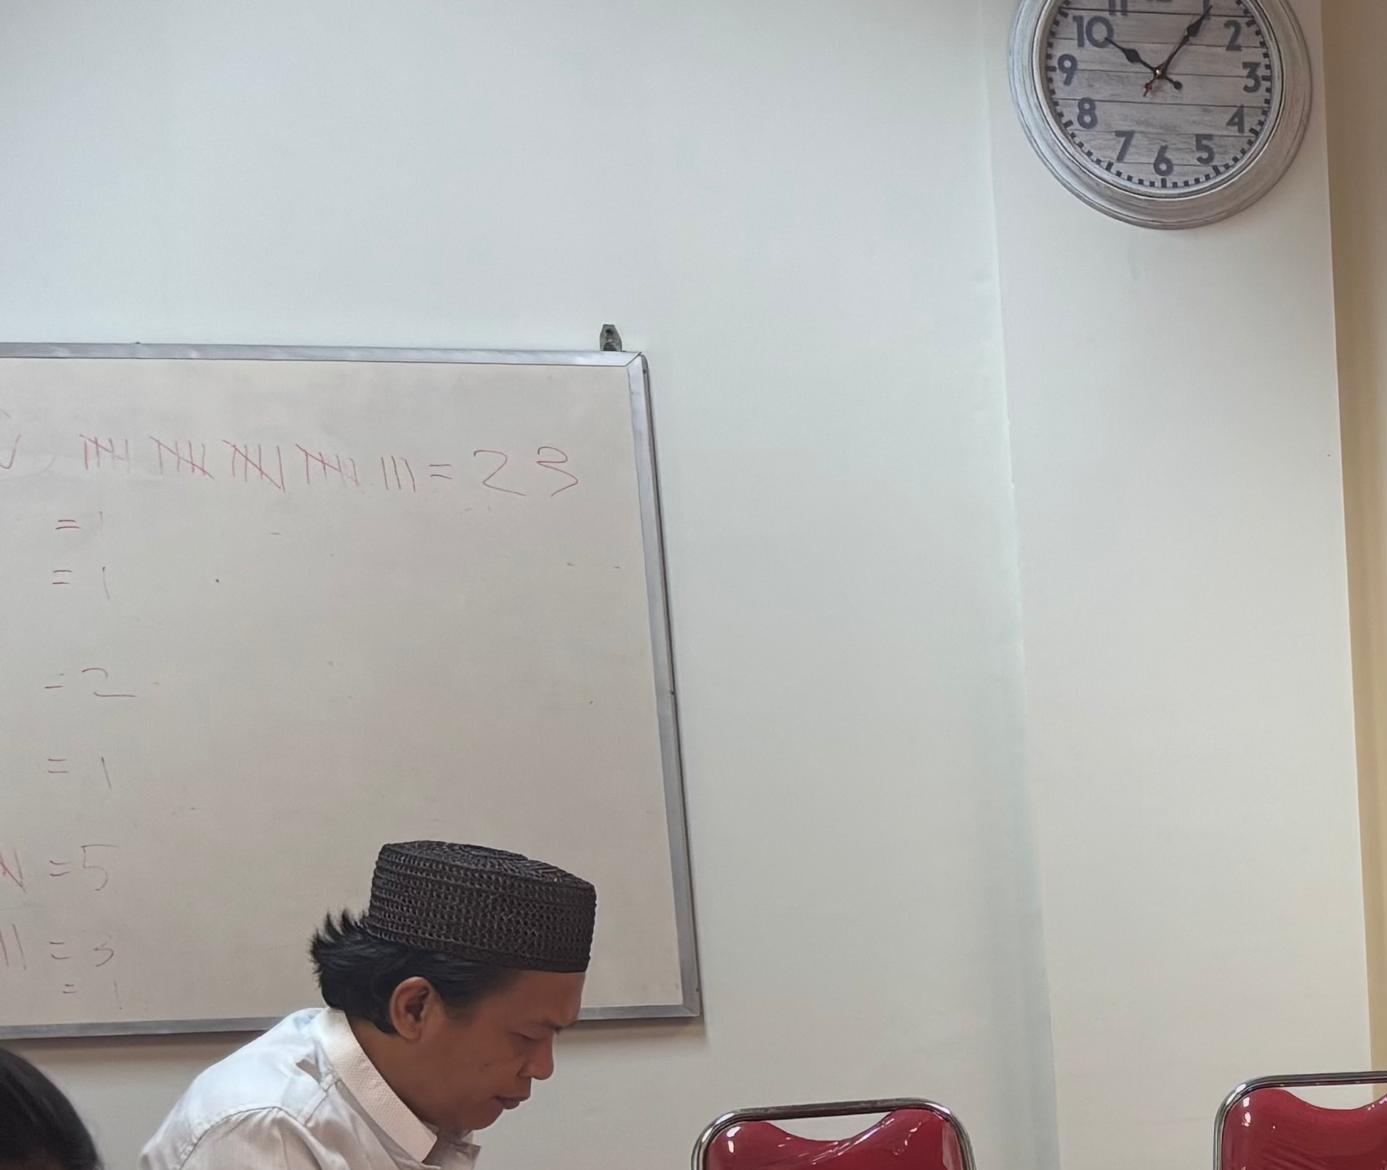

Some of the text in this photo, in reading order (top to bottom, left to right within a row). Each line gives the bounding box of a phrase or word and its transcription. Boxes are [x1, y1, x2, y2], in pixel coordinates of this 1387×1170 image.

[1073, 16, 1114, 48] 10
[1224, 20, 1242, 51] 2
[1058, 54, 1078, 86] 9
[1242, 61, 1261, 92] 3
[1077, 97, 1098, 129] 8
[1226, 104, 1244, 133] 4
[1116, 130, 1135, 162] 7
[1153, 145, 1173, 176] 6
[1195, 134, 1215, 164] 5
